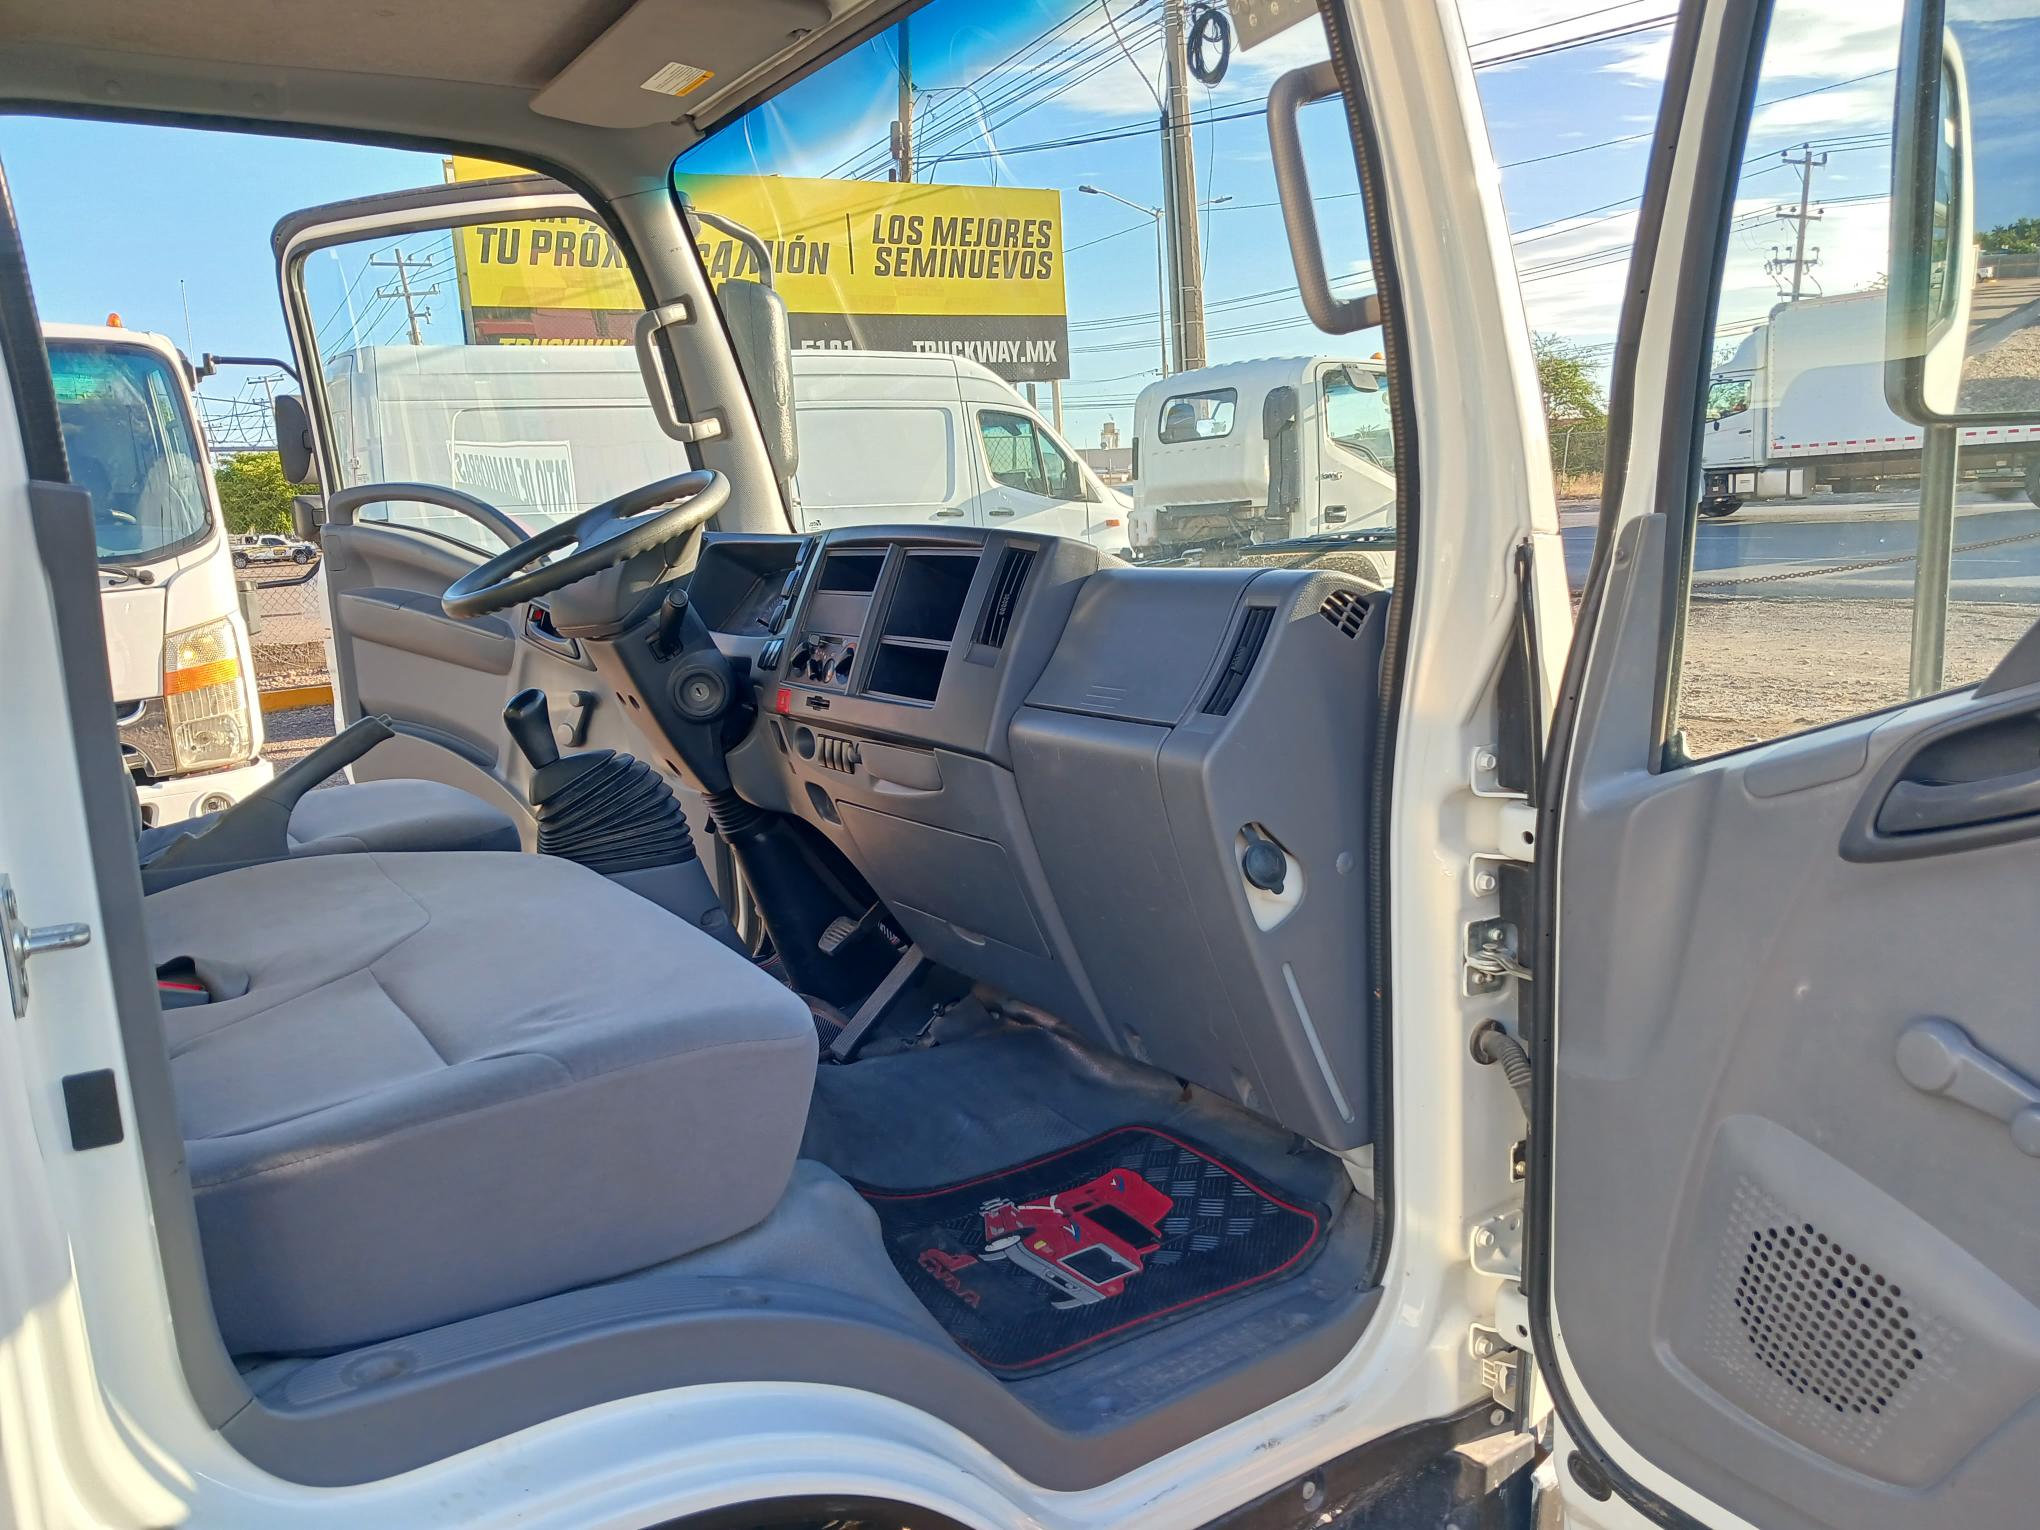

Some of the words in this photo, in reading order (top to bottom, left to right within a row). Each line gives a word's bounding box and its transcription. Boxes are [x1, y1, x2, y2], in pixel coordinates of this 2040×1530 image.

[476, 227, 521, 264] TU
[872, 214, 924, 246] LOS
[931, 216, 1053, 249] MEJORES
[874, 246, 1053, 280] SEMINUEVOS
